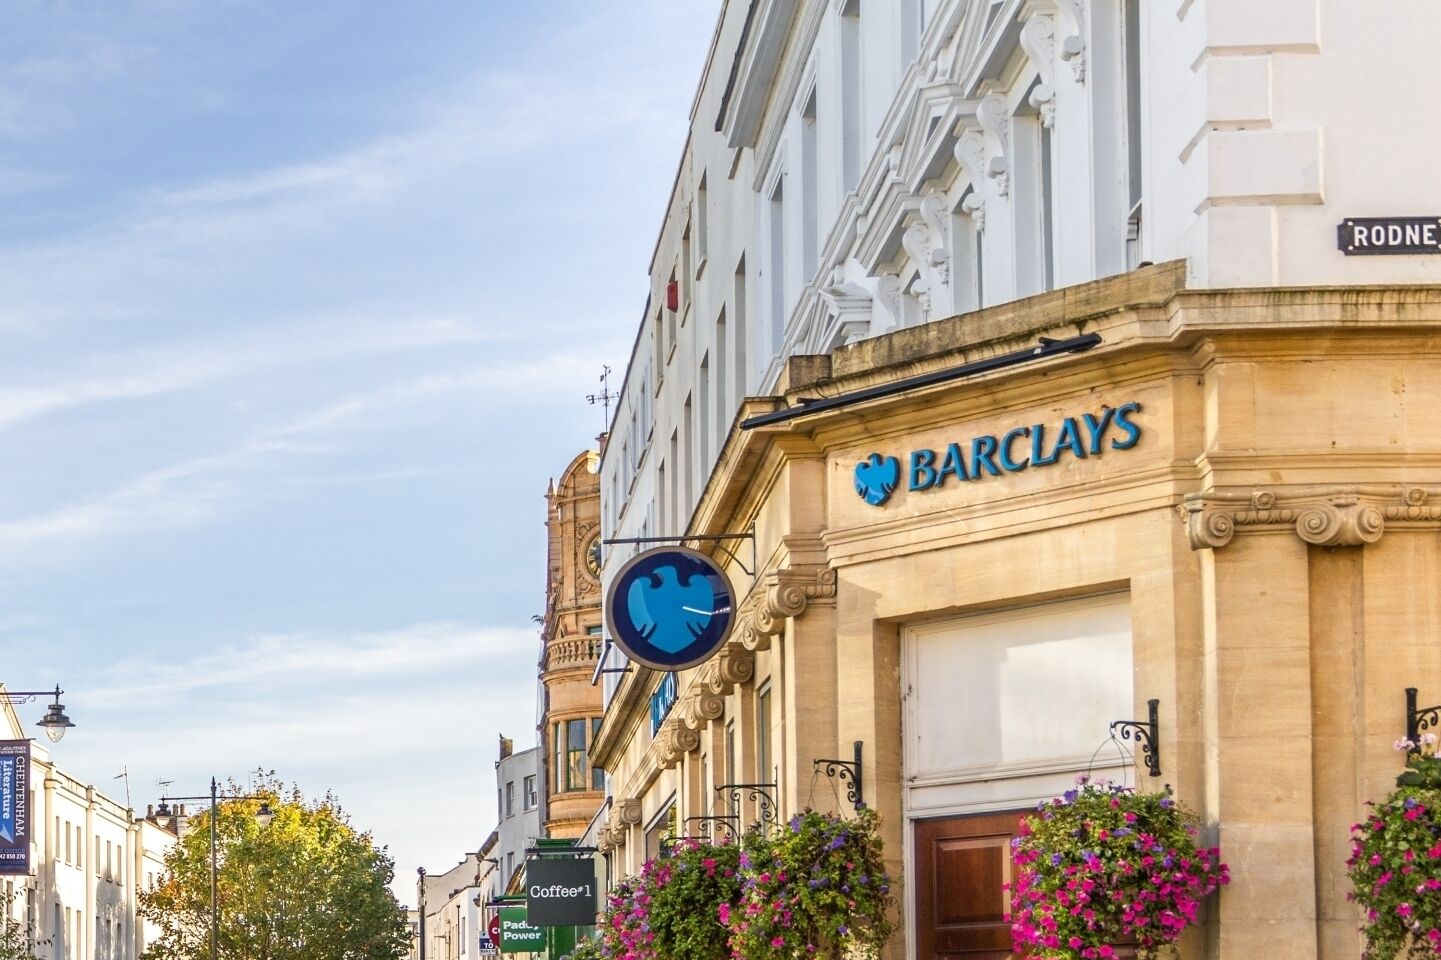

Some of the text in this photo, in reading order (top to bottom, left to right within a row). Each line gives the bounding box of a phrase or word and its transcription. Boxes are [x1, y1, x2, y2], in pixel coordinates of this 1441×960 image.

[1353, 224, 1441, 247] RODNE
[909, 402, 1143, 493] BARCLAYS
[2, 760, 13, 820] Literature
[15, 756, 25, 836] CHELTENHAM
[503, 920, 539, 931] Pad
[503, 931, 542, 941] Power
